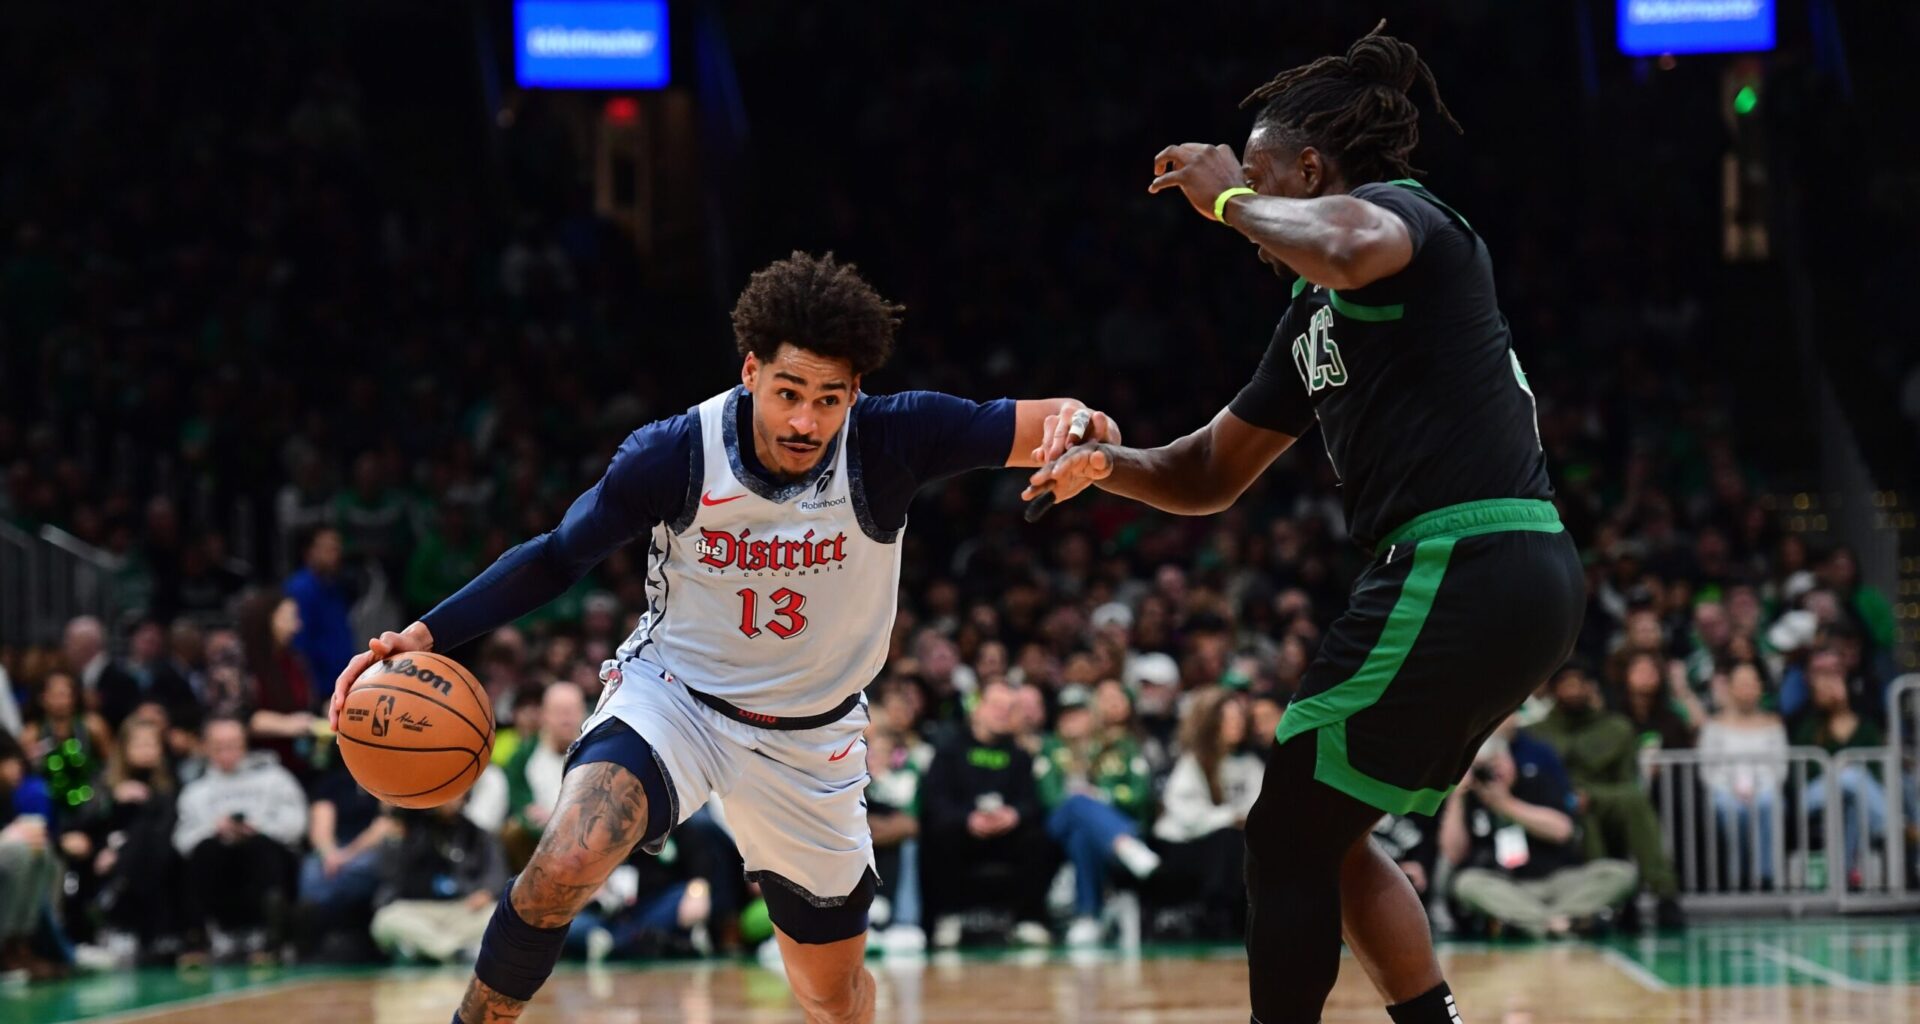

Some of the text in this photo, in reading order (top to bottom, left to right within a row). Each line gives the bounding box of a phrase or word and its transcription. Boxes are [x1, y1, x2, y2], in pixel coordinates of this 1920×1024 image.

[801, 496, 846, 510] Robinhood
[694, 526, 847, 571] the District
[708, 564, 843, 578] OF COLUMBIA
[736, 587, 808, 640] 13
